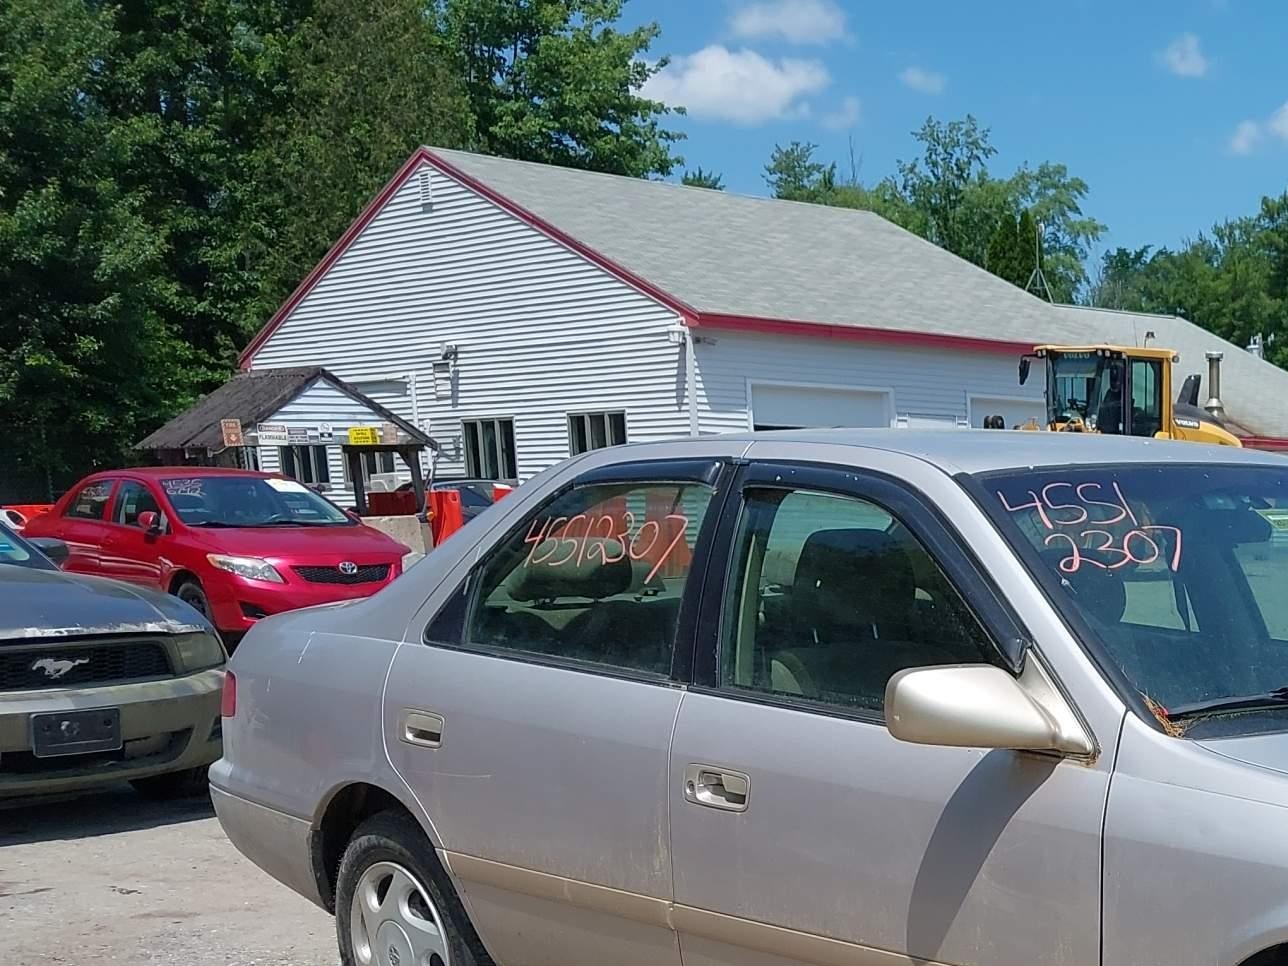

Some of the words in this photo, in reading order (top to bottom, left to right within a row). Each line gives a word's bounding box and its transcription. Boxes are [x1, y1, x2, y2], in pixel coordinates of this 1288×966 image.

[997, 482, 1138, 529] 4551
[523, 512, 688, 584] 45512307
[1044, 524, 1182, 572] 2307
